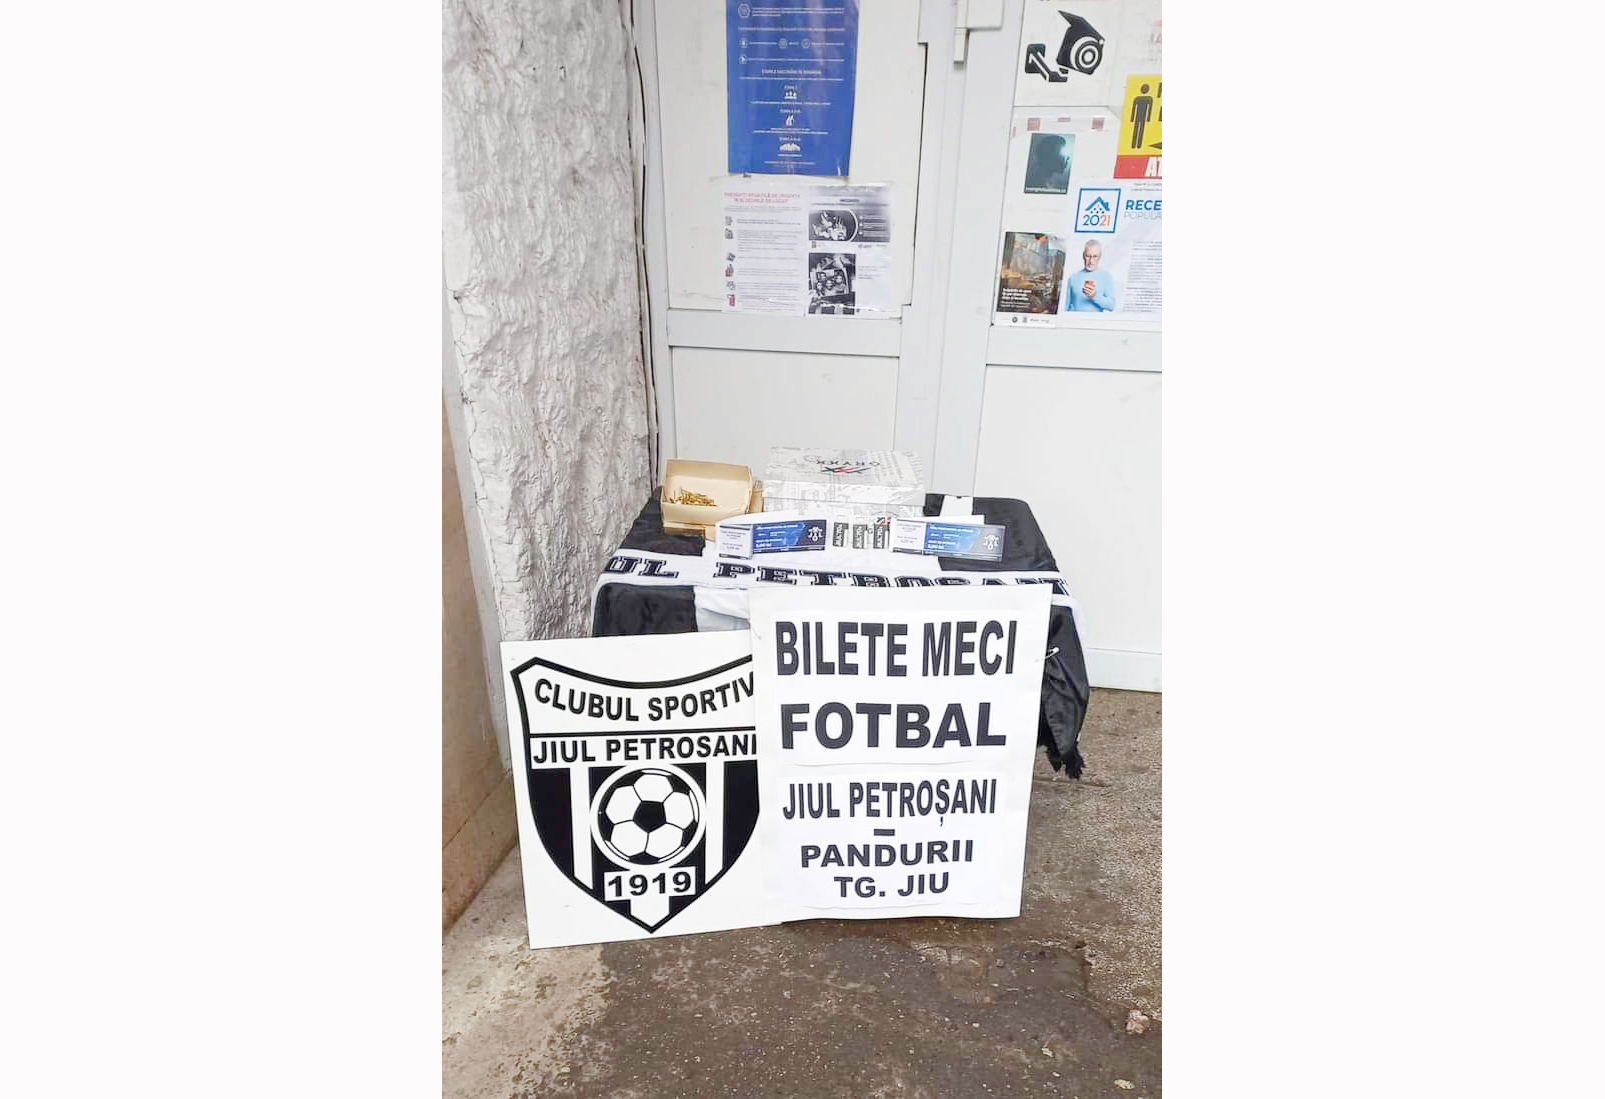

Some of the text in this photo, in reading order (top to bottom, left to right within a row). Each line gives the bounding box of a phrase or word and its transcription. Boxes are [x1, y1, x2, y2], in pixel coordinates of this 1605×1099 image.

[1082, 214, 1111, 226] 2021
[1125, 199, 1162, 211] RECE
[775, 620, 1018, 677] BILETE MECI
[534, 671, 754, 722] CLUBUL SPORTIV
[780, 701, 1007, 749] FOTBAL
[533, 733, 757, 764] JIUL PETROSANI
[783, 778, 997, 827] JIUL PETROȘANI
[800, 839, 973, 868] PANDURII
[607, 871, 692, 897] 1919
[834, 871, 949, 898] TG. JIU
